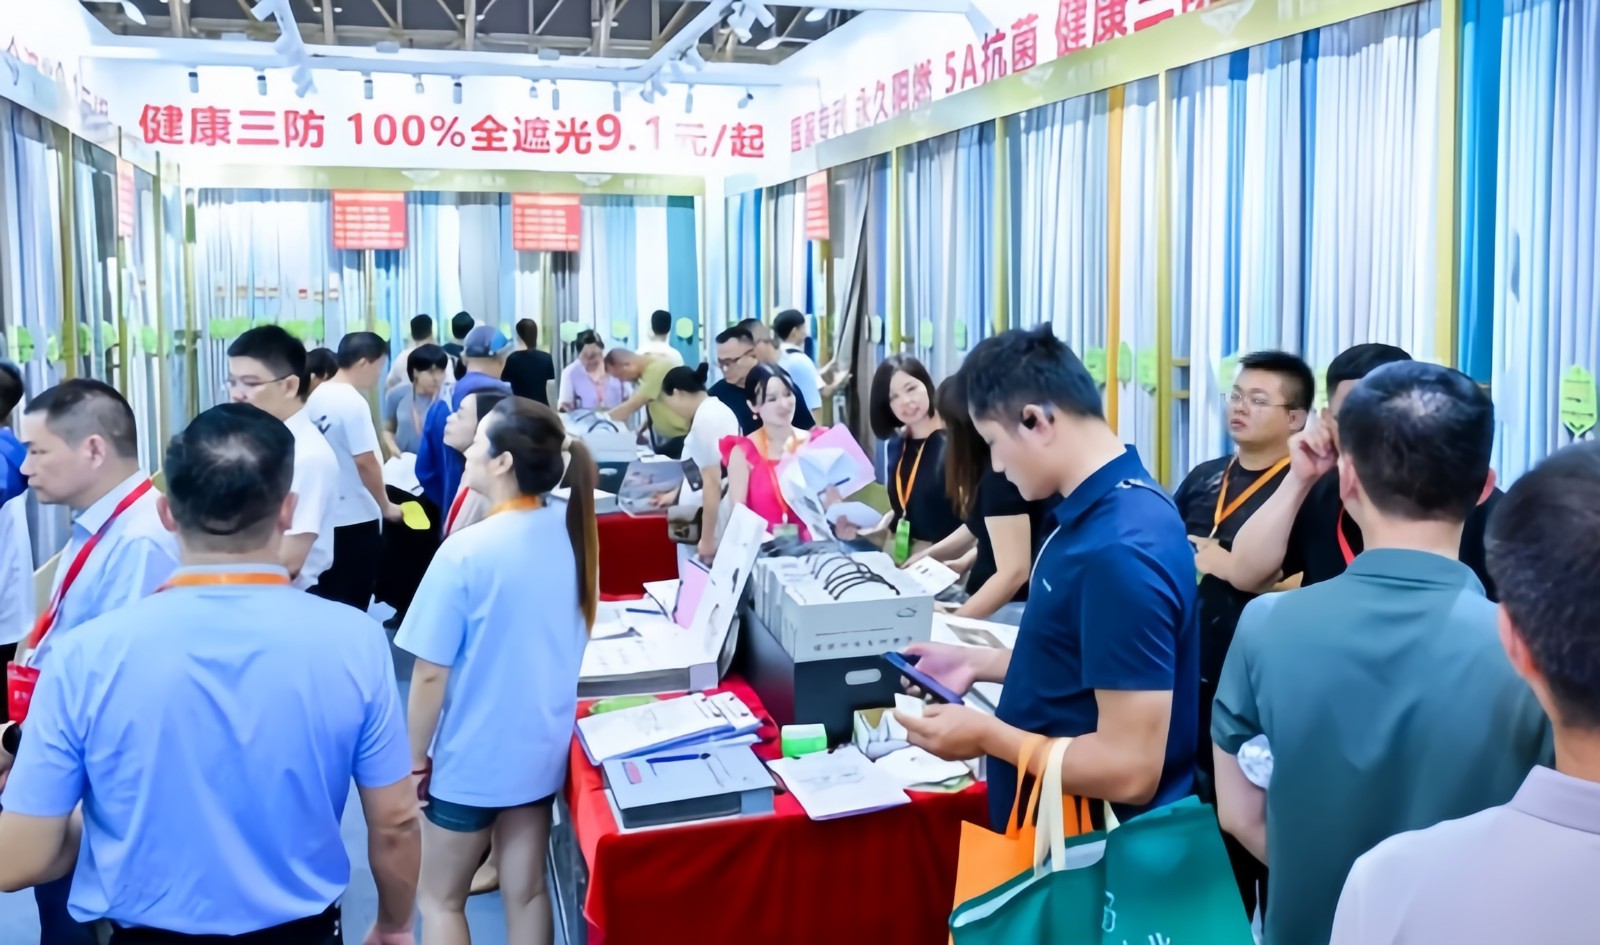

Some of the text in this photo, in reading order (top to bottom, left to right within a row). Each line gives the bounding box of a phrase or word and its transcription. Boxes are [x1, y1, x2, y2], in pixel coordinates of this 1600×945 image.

[945, 13, 1040, 95] 5A抗菌
[139, 104, 765, 158] 健康三防 100%全遮光9.1元/起
